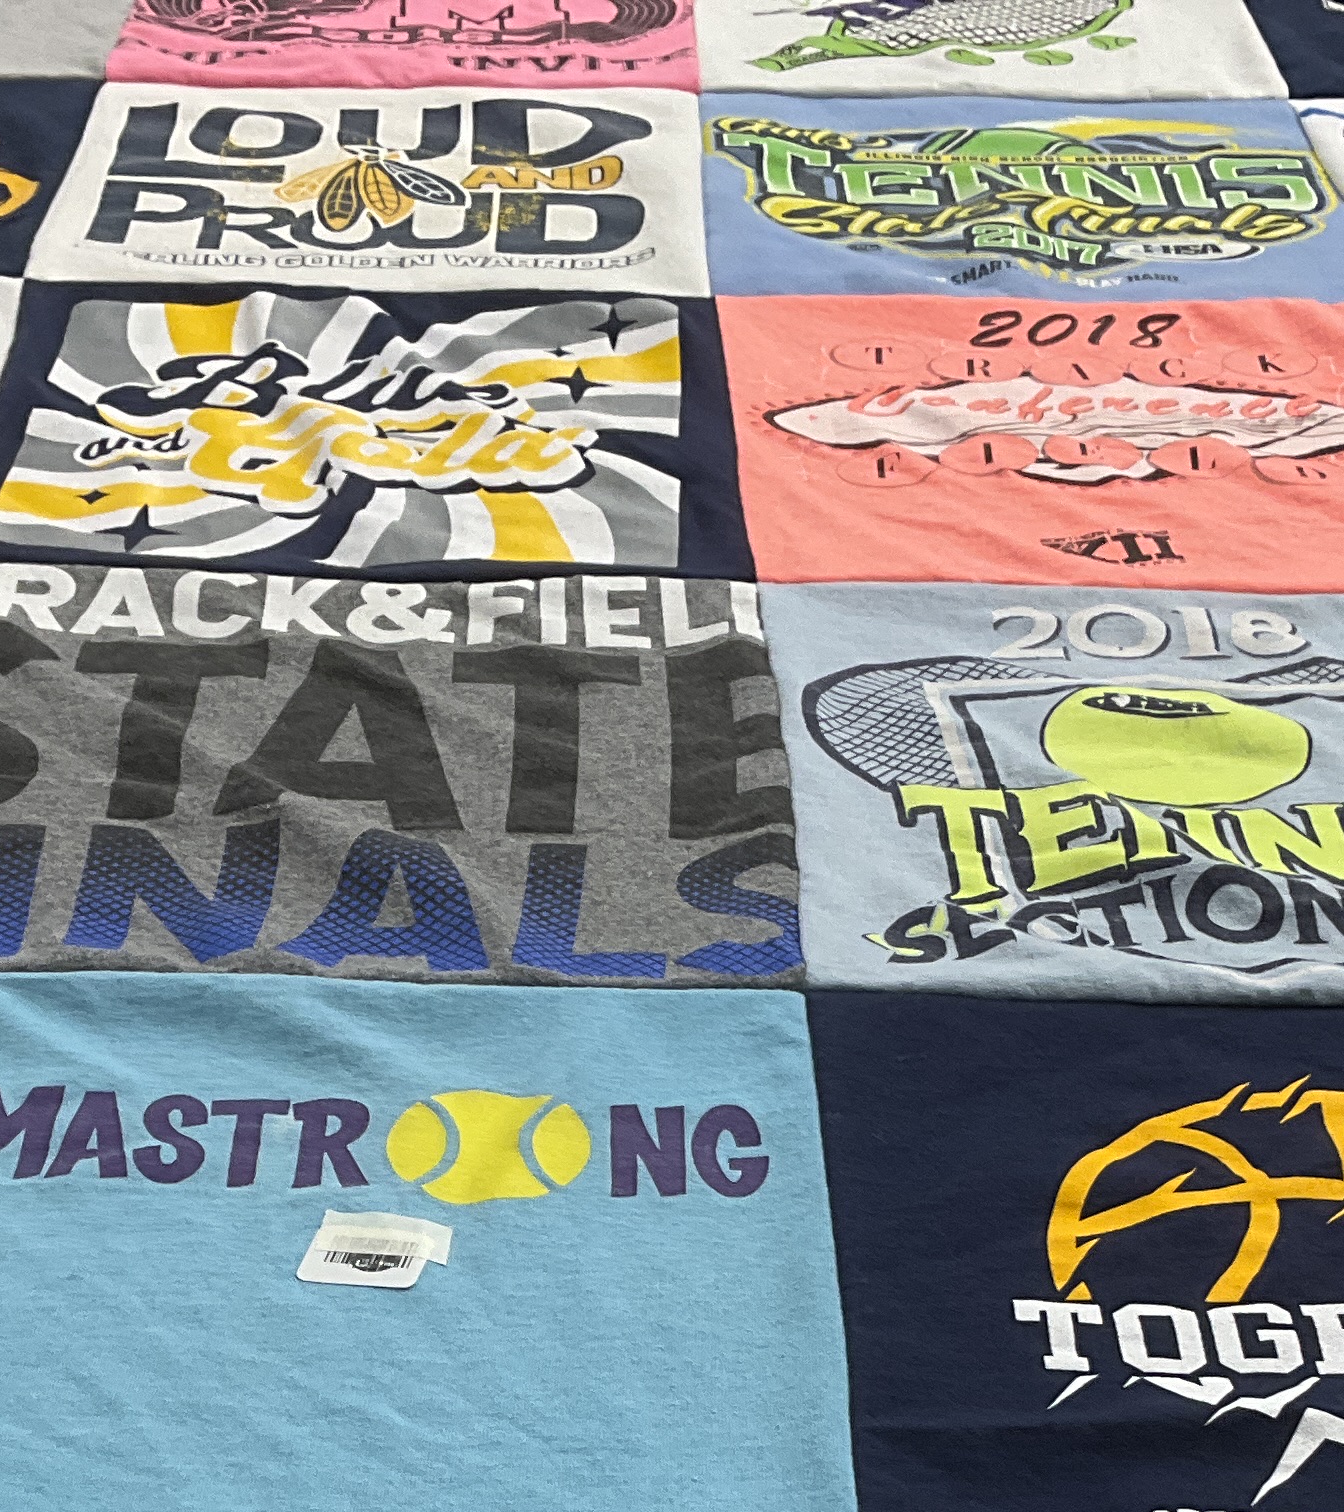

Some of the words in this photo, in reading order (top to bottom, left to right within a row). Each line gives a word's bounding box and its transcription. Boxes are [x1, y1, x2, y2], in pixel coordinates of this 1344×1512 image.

[107, 99, 653, 184] LOUD
[459, 156, 623, 191] AND
[720, 132, 1321, 213] TENNIS
[84, 180, 646, 256] PROUD
[124, 249, 268, 269] ERLING
[970, 223, 1103, 266] 2017
[968, 310, 1182, 349] 2018
[78, 429, 191, 462] and
[991, 605, 1311, 662] 2018
